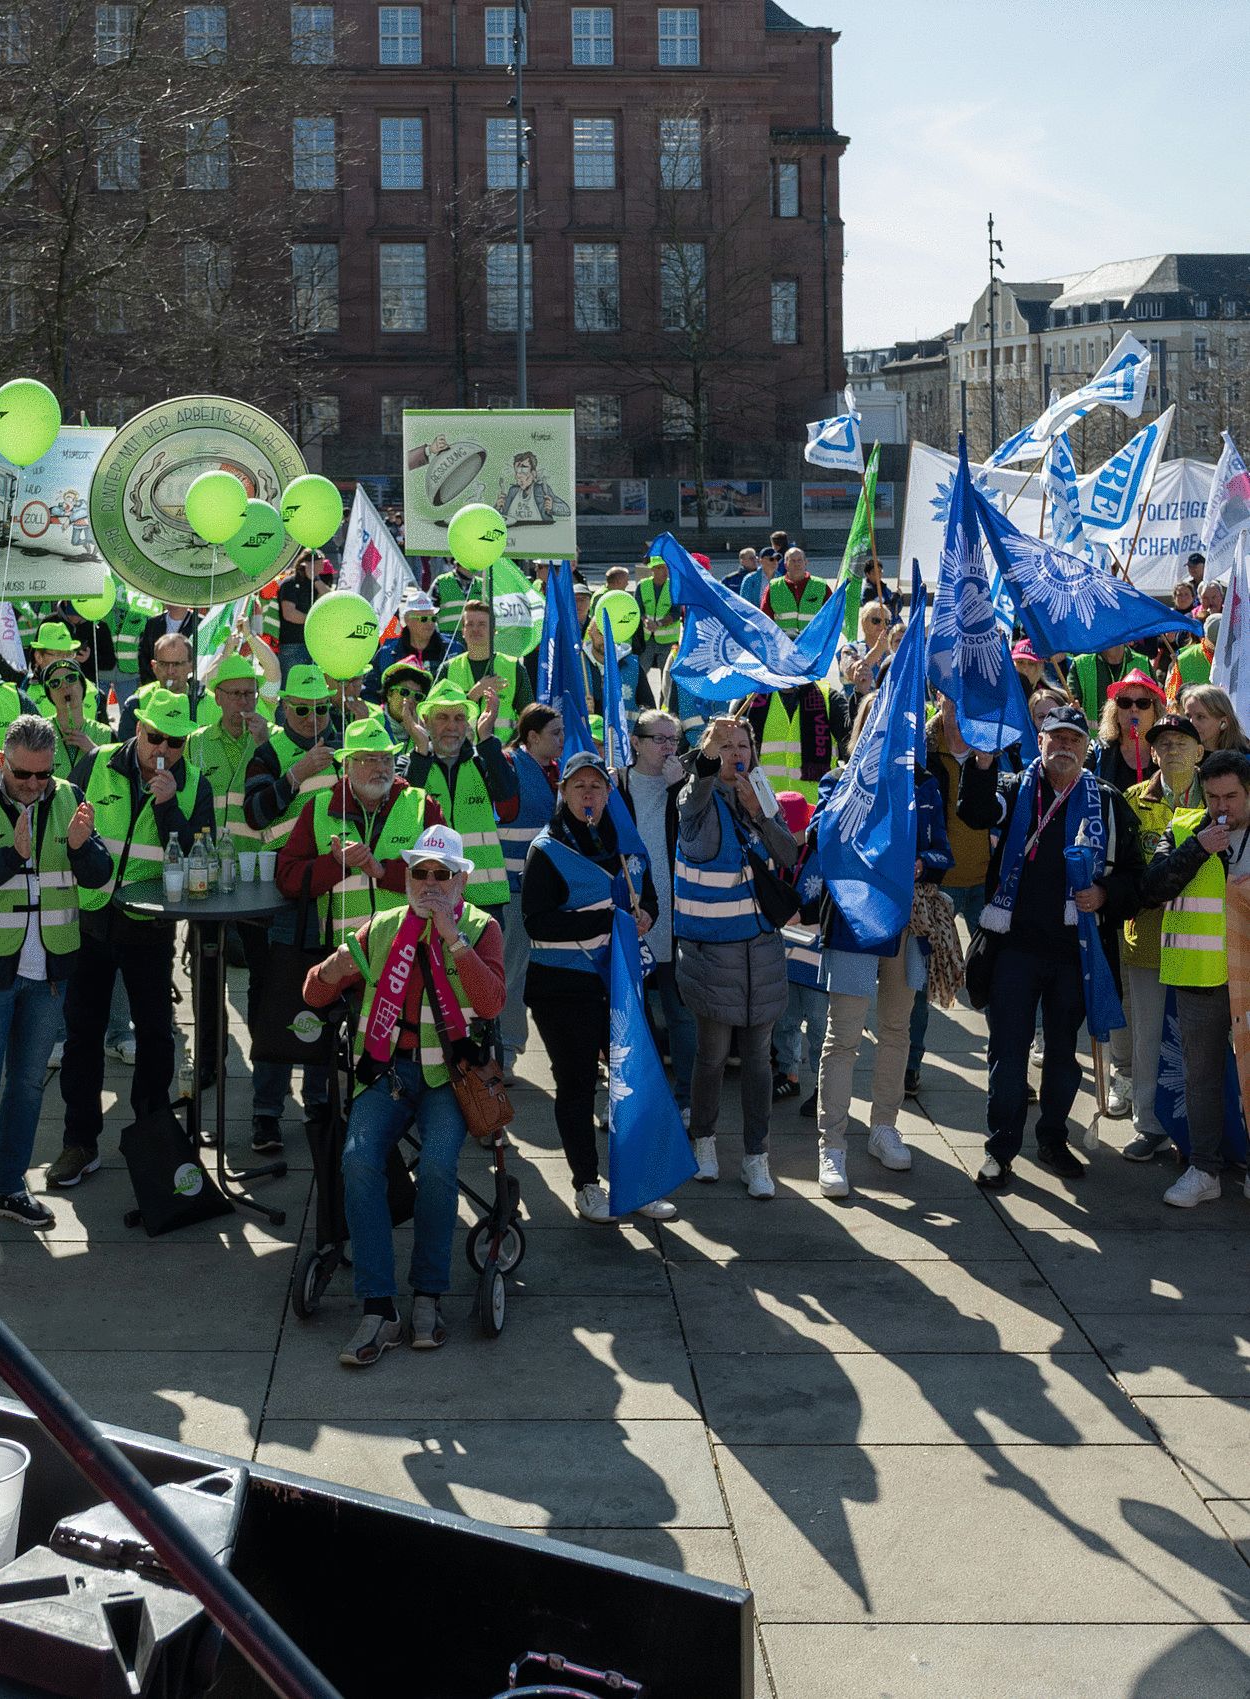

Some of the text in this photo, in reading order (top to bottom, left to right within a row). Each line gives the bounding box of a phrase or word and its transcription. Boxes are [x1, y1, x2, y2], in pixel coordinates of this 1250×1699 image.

[101, 462, 123, 512] RUNTER
[119, 435, 142, 461] MIT
[143, 415, 169, 439] DER
[176, 406, 263, 435] ARBEITSZEIT
[262, 432, 286, 455] BEI
[430, 447, 468, 484] BESOLDUNG
[24, 512, 46, 525] ZOLL
[249, 536, 267, 545] BDZ
[486, 530, 500, 541] BDZ
[105, 527, 136, 568] BEVOR
[28, 580, 47, 591] HER
[356, 624, 374, 636] BDZ
[814, 713, 830, 757] vbba
[423, 836, 445, 849] dbb
[388, 943, 416, 995] dbb
